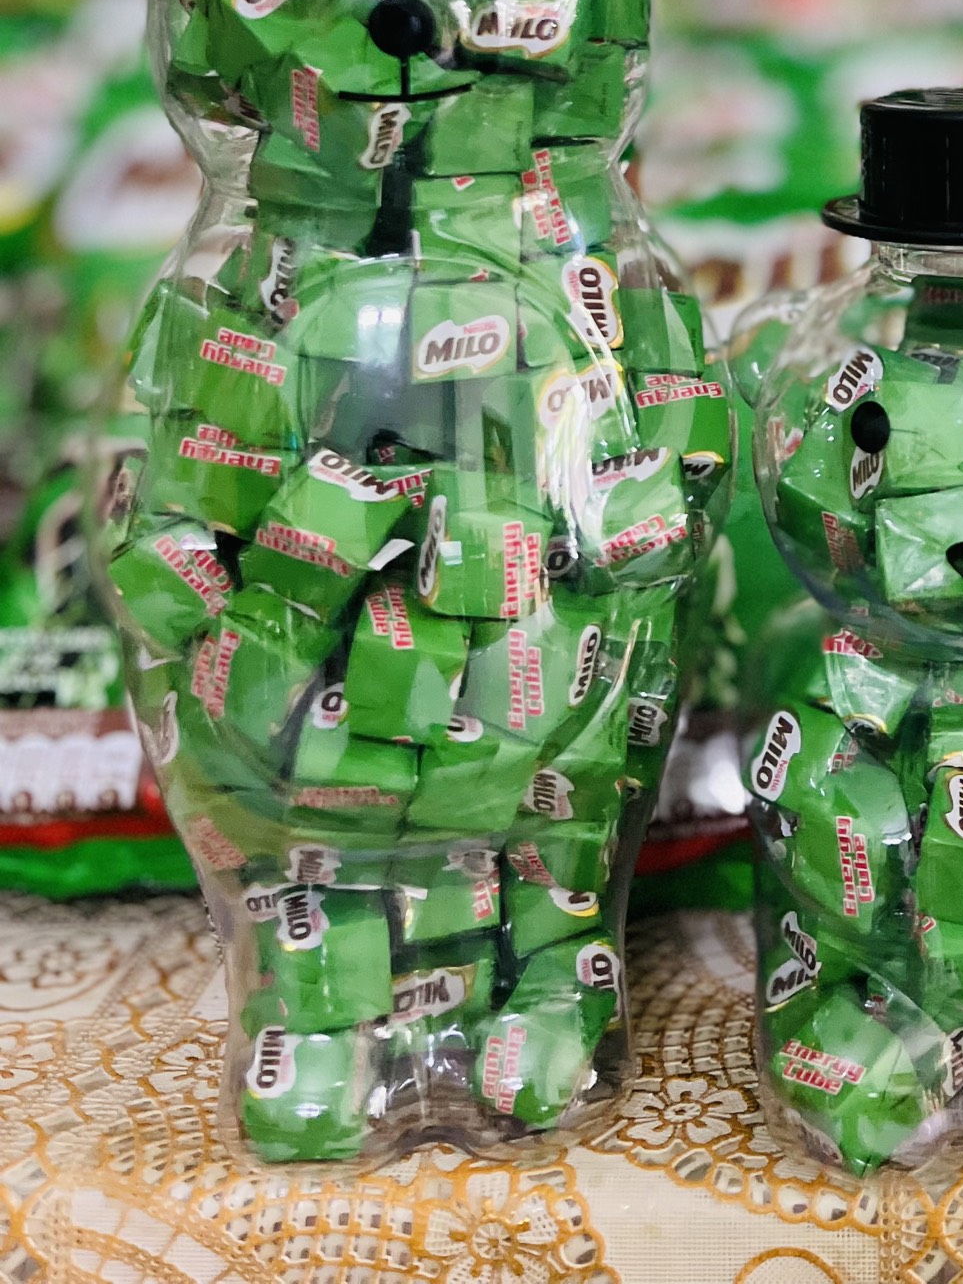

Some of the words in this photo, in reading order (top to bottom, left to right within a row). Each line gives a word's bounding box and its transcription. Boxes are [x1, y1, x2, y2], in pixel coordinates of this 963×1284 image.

[201, 340, 287, 386] Energy
[424, 333, 500, 365] MILO
[636, 382, 724, 407] Energy
[833, 350, 873, 405] MILO
[502, 522, 523, 616] Energy
[509, 630, 527, 729] Energy
[526, 647, 544, 716] Cube
[574, 634, 598, 699] MILO
[630, 705, 658, 742] MILO
[756, 717, 793, 789] MILO
[532, 774, 556, 812] MILO
[836, 817, 858, 916] Energy
[853, 834, 875, 903] Cube
[284, 892, 311, 942] MILO
[784, 922, 816, 968] MILO
[257, 1029, 284, 1088] MILO
[780, 1039, 865, 1084] Energy
[782, 1060, 842, 1094] Cube
